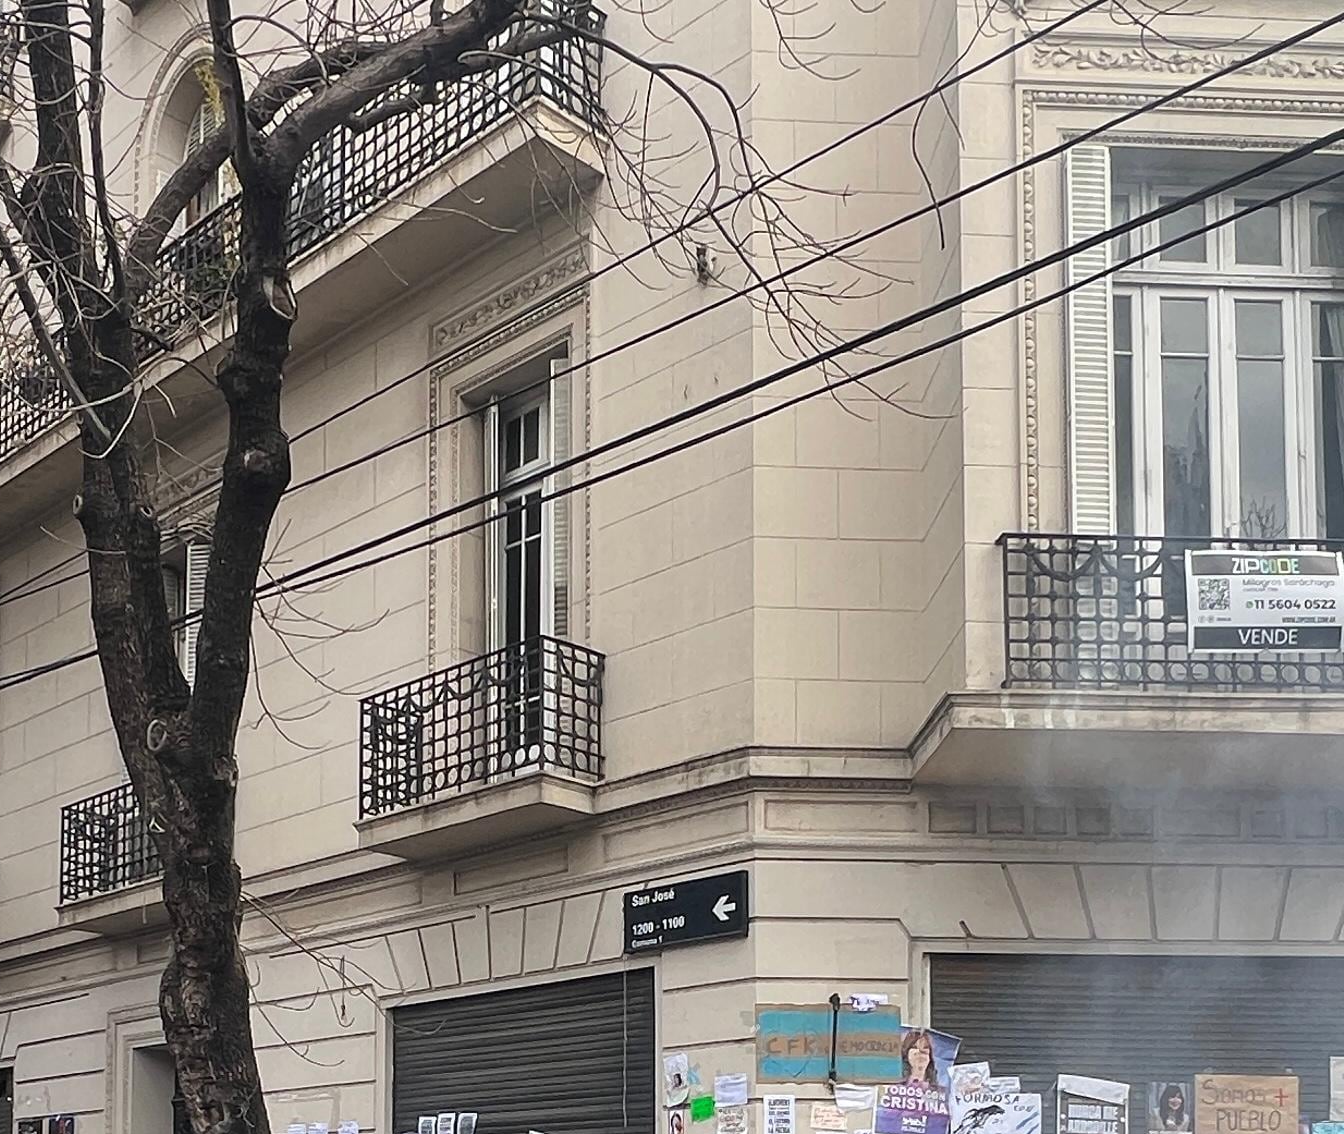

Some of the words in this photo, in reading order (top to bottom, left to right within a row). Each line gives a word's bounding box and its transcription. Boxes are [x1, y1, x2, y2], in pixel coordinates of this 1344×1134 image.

[1232, 558, 1300, 574] ZIPCODE
[1255, 599, 1265, 609] 11
[1268, 599, 1301, 609] 5604
[1304, 599, 1336, 610] 0522
[1238, 629, 1298, 645] VENDE
[631, 894, 650, 907] San
[652, 888, 675, 903] José
[632, 921, 654, 936] 1200
[662, 915, 685, 930] 1100
[767, 1036, 819, 1055] CFK
[883, 1085, 924, 1097] TODOS
[924, 1090, 946, 1101] CON
[880, 1095, 949, 1115] CRISTINA
[1216, 1108, 1282, 1132] PUEBLO
